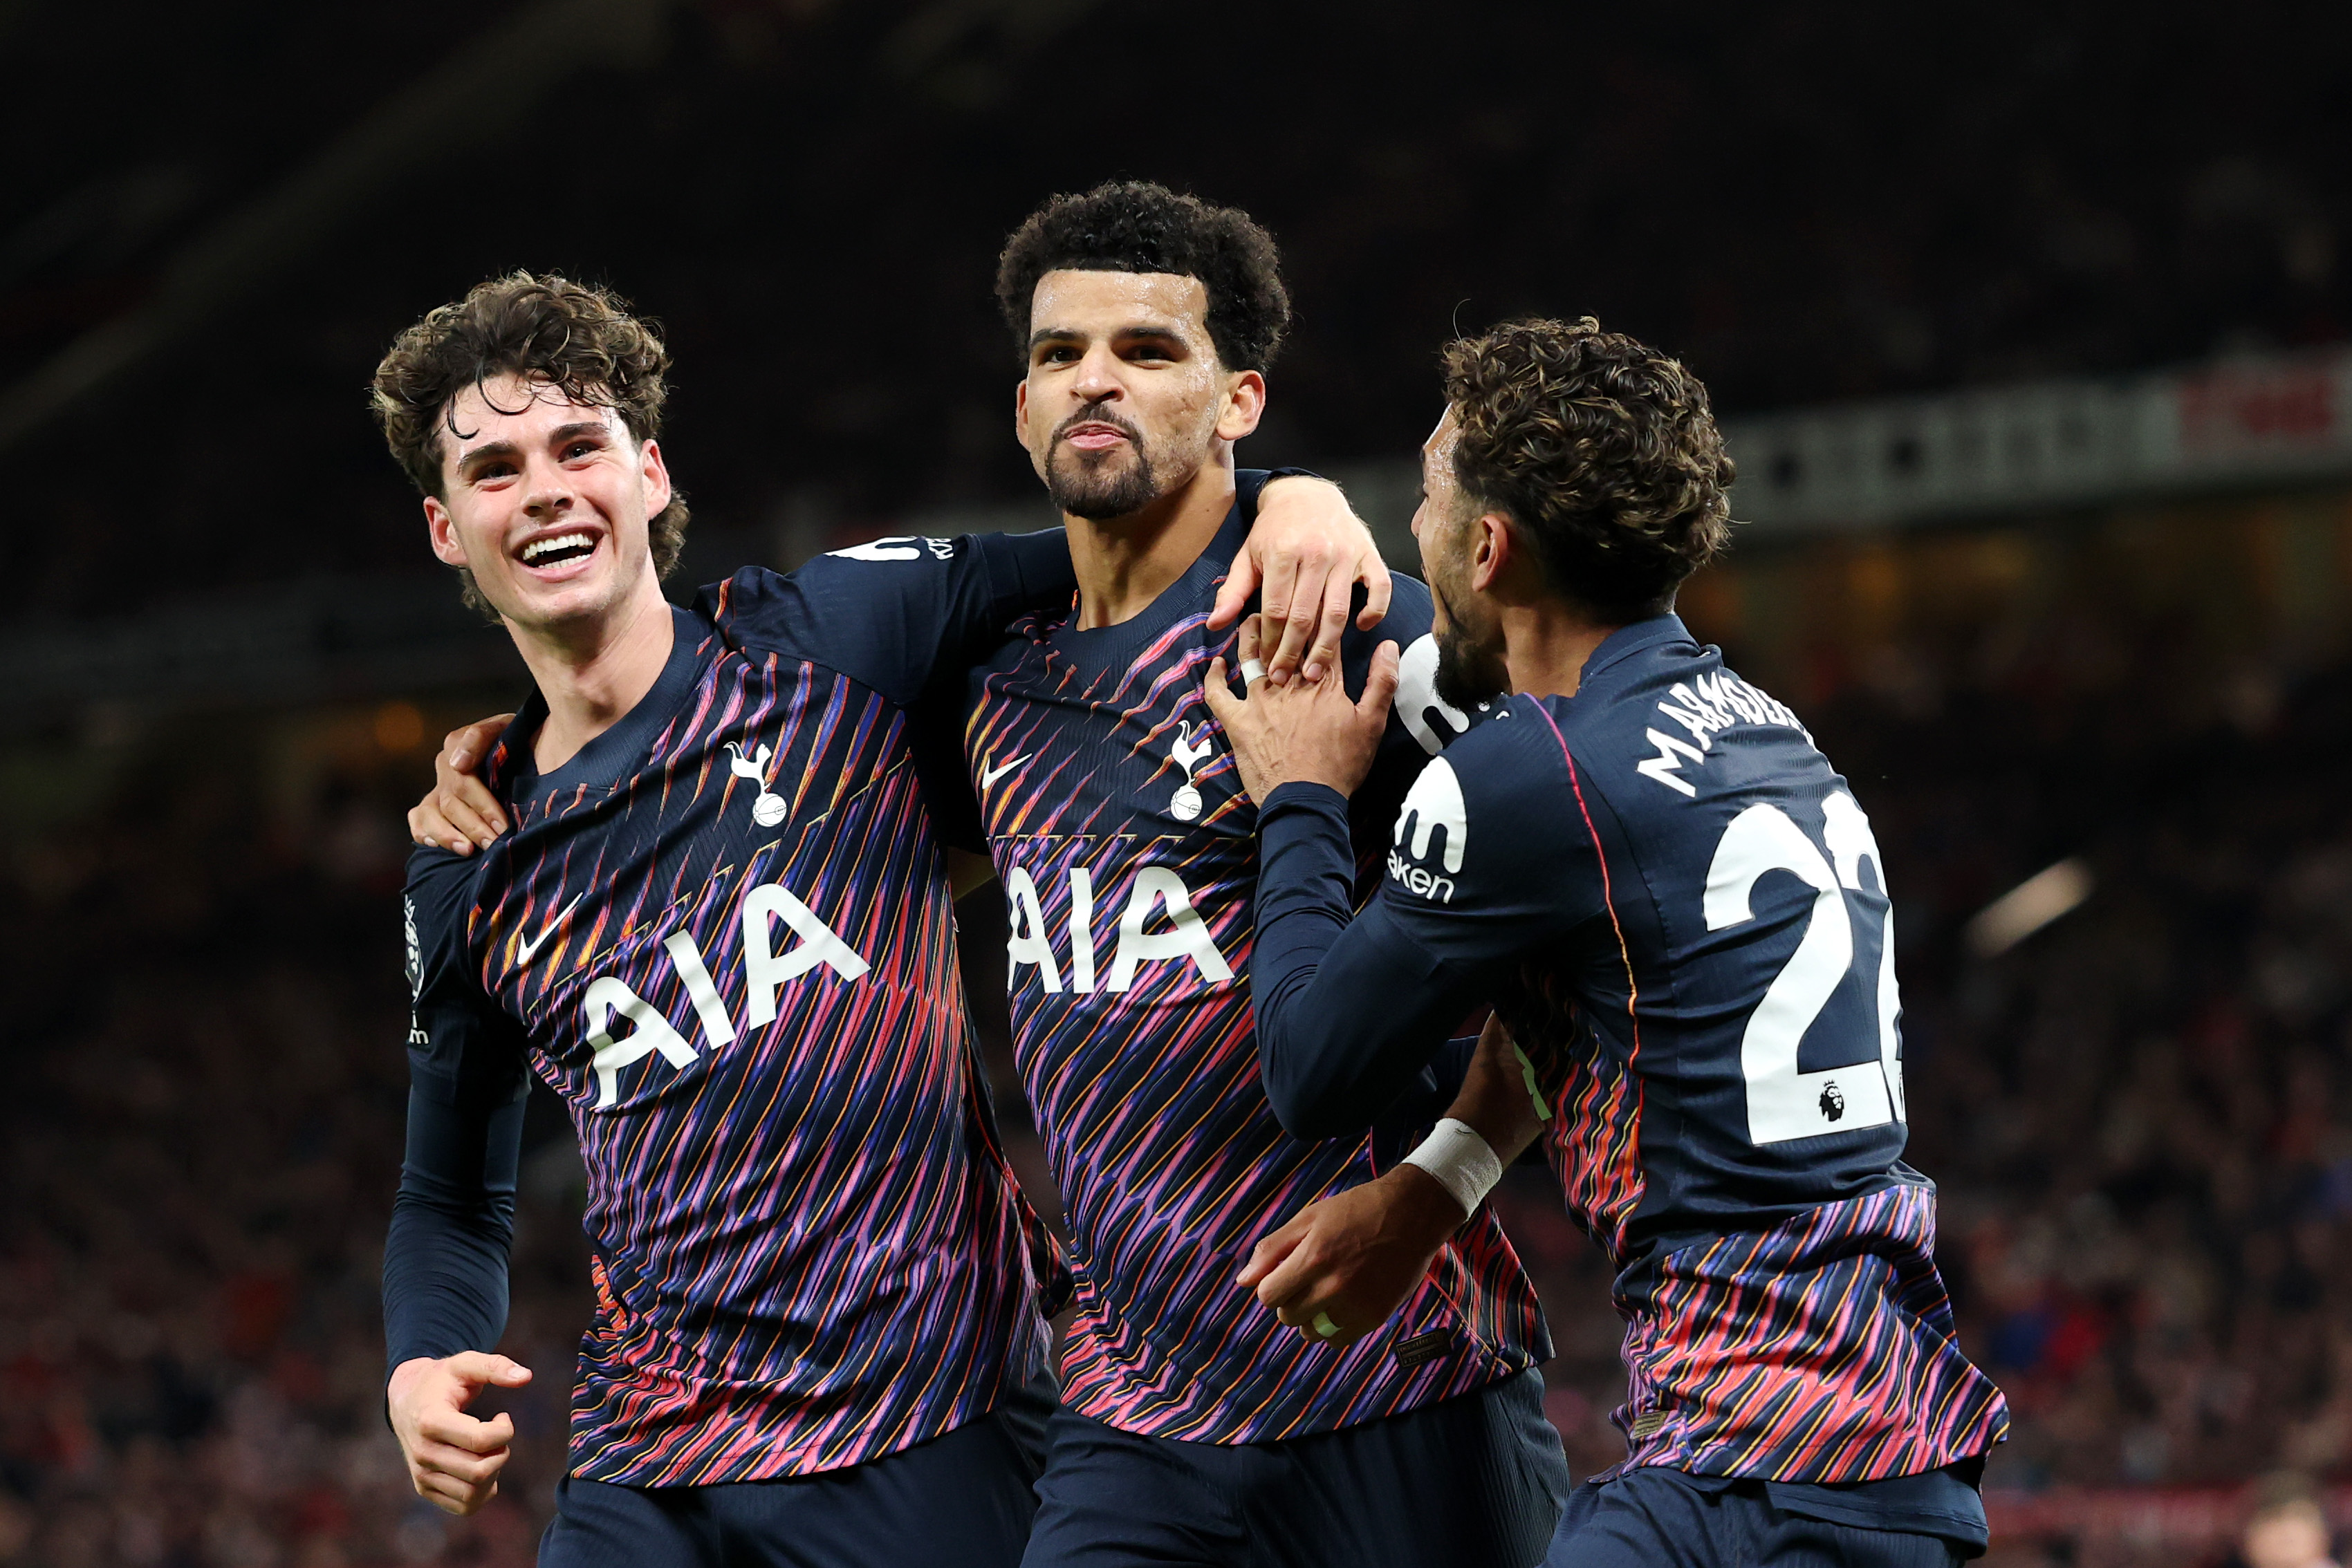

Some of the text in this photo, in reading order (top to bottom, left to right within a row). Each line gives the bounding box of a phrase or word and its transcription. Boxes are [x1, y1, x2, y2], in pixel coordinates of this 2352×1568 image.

[1007, 866, 1236, 993] AIA
[1387, 848, 1455, 904] aken
[584, 884, 872, 1109] AIA
